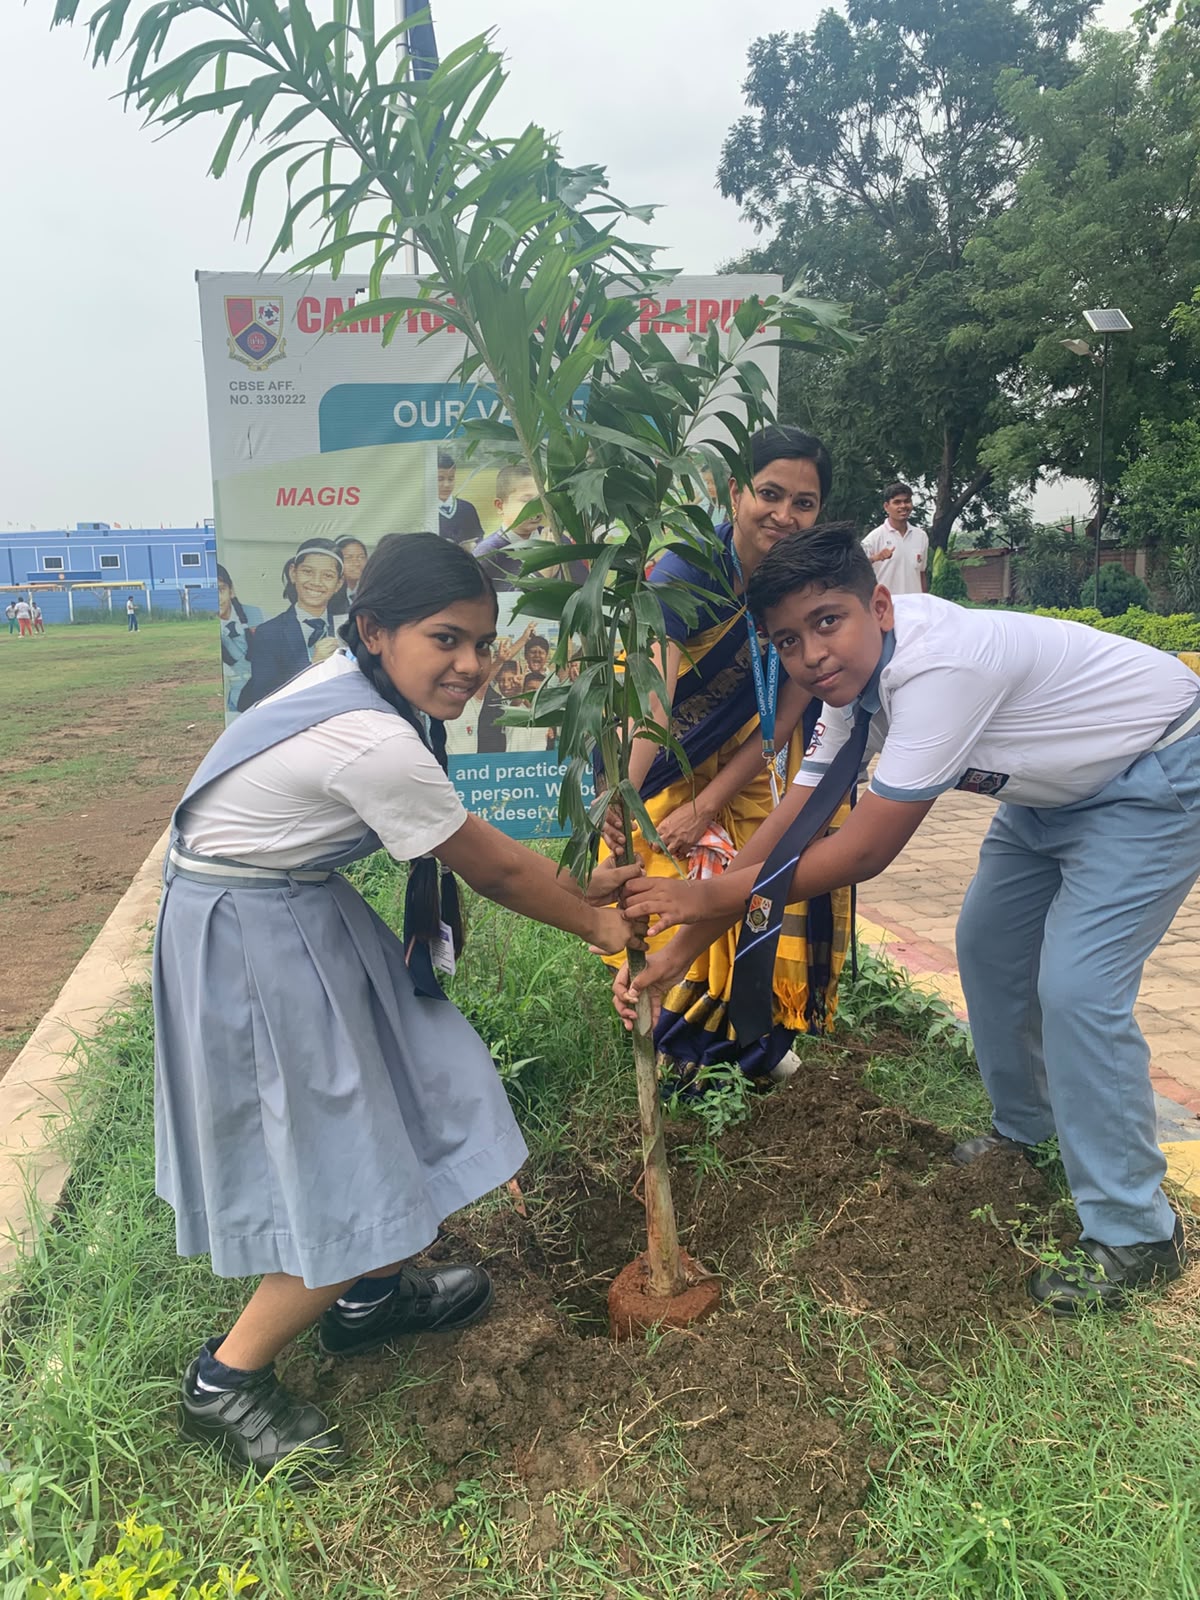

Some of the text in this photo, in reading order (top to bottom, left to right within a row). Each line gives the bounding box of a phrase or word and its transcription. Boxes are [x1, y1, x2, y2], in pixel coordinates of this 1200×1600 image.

[639, 298, 766, 334] RAIPU
[229, 380, 295, 392] CBSE AFF.
[230, 394, 306, 405] NO. 3330222
[393, 400, 466, 428] OUR
[276, 486, 361, 506] MAGIS
[455, 765, 490, 781] and
[496, 762, 568, 782] practice
[471, 786, 540, 804] person.
